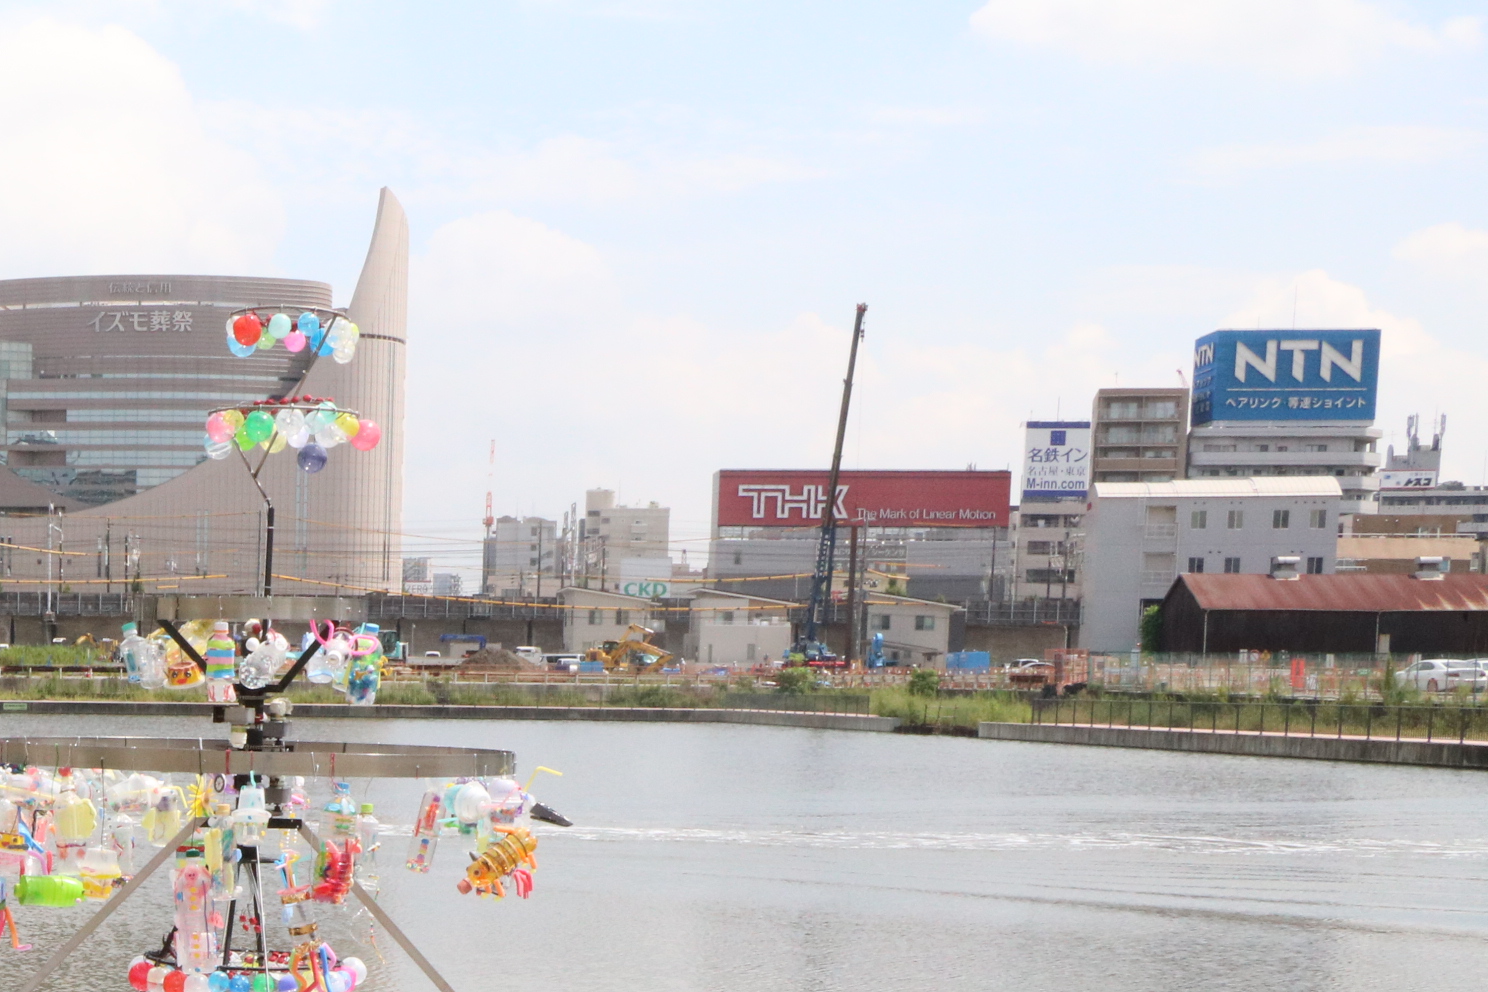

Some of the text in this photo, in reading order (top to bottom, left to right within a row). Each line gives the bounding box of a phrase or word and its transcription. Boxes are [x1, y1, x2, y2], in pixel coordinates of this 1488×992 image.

[88, 311, 193, 332] イズモ葬祭
[1235, 339, 1364, 384] NTN
[1027, 447, 1088, 463] 名鉄イン
[1026, 477, 1085, 489] M-inn.com
[738, 484, 849, 519] THK
[856, 508, 996, 520] The Mark of Linear Motion
[624, 582, 667, 597] CKD
